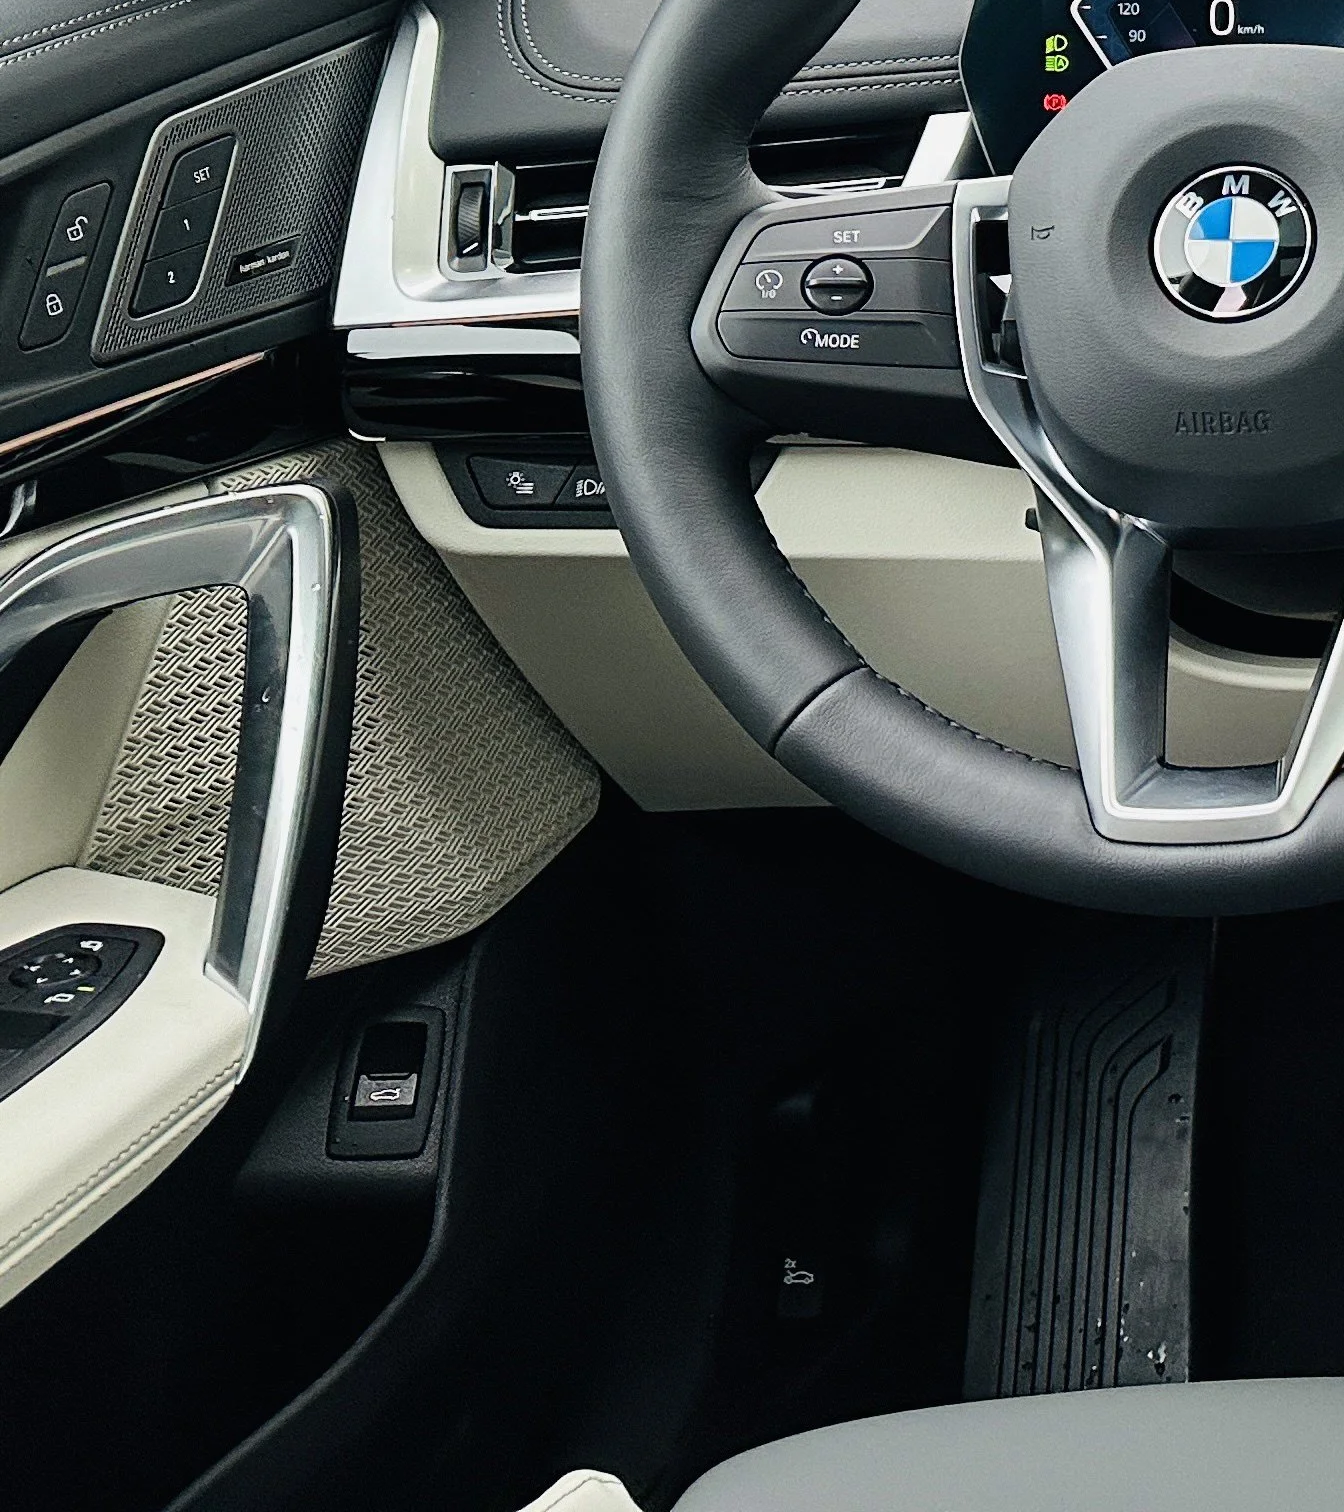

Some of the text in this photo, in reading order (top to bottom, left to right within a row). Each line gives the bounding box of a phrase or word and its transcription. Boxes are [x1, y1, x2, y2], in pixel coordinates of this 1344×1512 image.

[1118, 3, 1140, 16] 120
[1128, 29, 1146, 43] 90
[1237, 24, 1265, 35] km/h
[193, 166, 211, 184] SET
[1175, 174, 1298, 220] BMW
[183, 218, 191, 231] 1
[833, 230, 861, 243] SET
[167, 270, 177, 284] 2
[814, 333, 860, 349] MODE
[1174, 409, 1272, 434] AIRBAG
